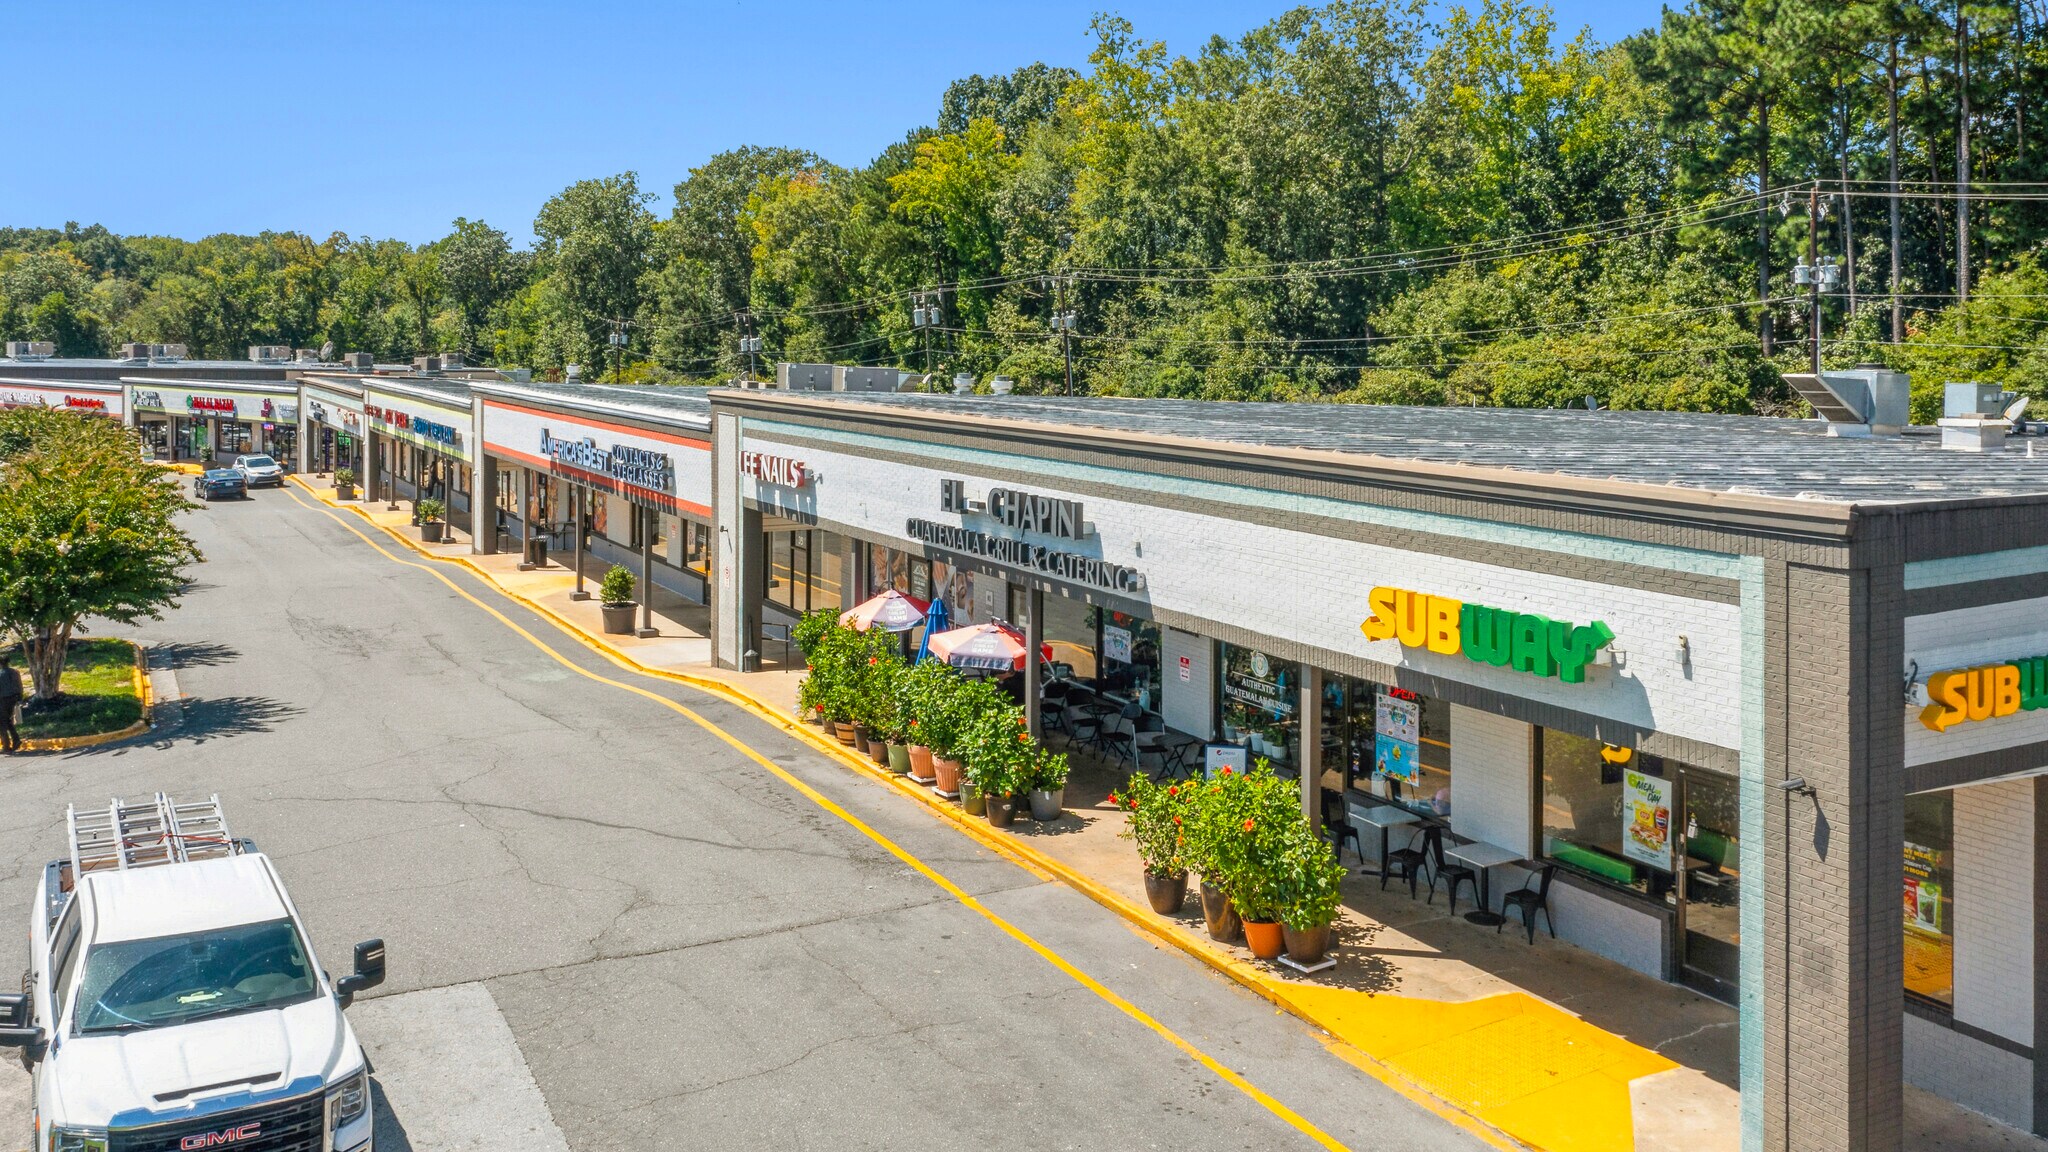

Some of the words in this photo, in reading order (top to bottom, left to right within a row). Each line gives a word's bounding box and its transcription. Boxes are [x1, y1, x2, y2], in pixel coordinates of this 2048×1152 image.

[583, 436, 609, 471] BEST
[611, 444, 656, 470] CONTACTS
[611, 462, 666, 491] EYEGLASSES
[739, 450, 758, 479] LEE
[760, 454, 801, 488] NAILS
[941, 478, 964, 513] EL
[988, 487, 1083, 541] CHAPIN
[906, 517, 983, 555] GUATEMALA
[985, 535, 1029, 567] GRILL
[1029, 546, 1046, 571] &
[1045, 551, 1138, 593] CATERING
[1360, 586, 1616, 684] SUBWAY
[1225, 684, 1268, 705] GUATEMALAN
[1268, 697, 1293, 714] CUISINE
[1241, 678, 1276, 696] AUTHENTIC
[1636, 780, 1656, 794] MEAL
[1646, 793, 1662, 804] DAY
[181, 1122, 261, 1151] GMC
